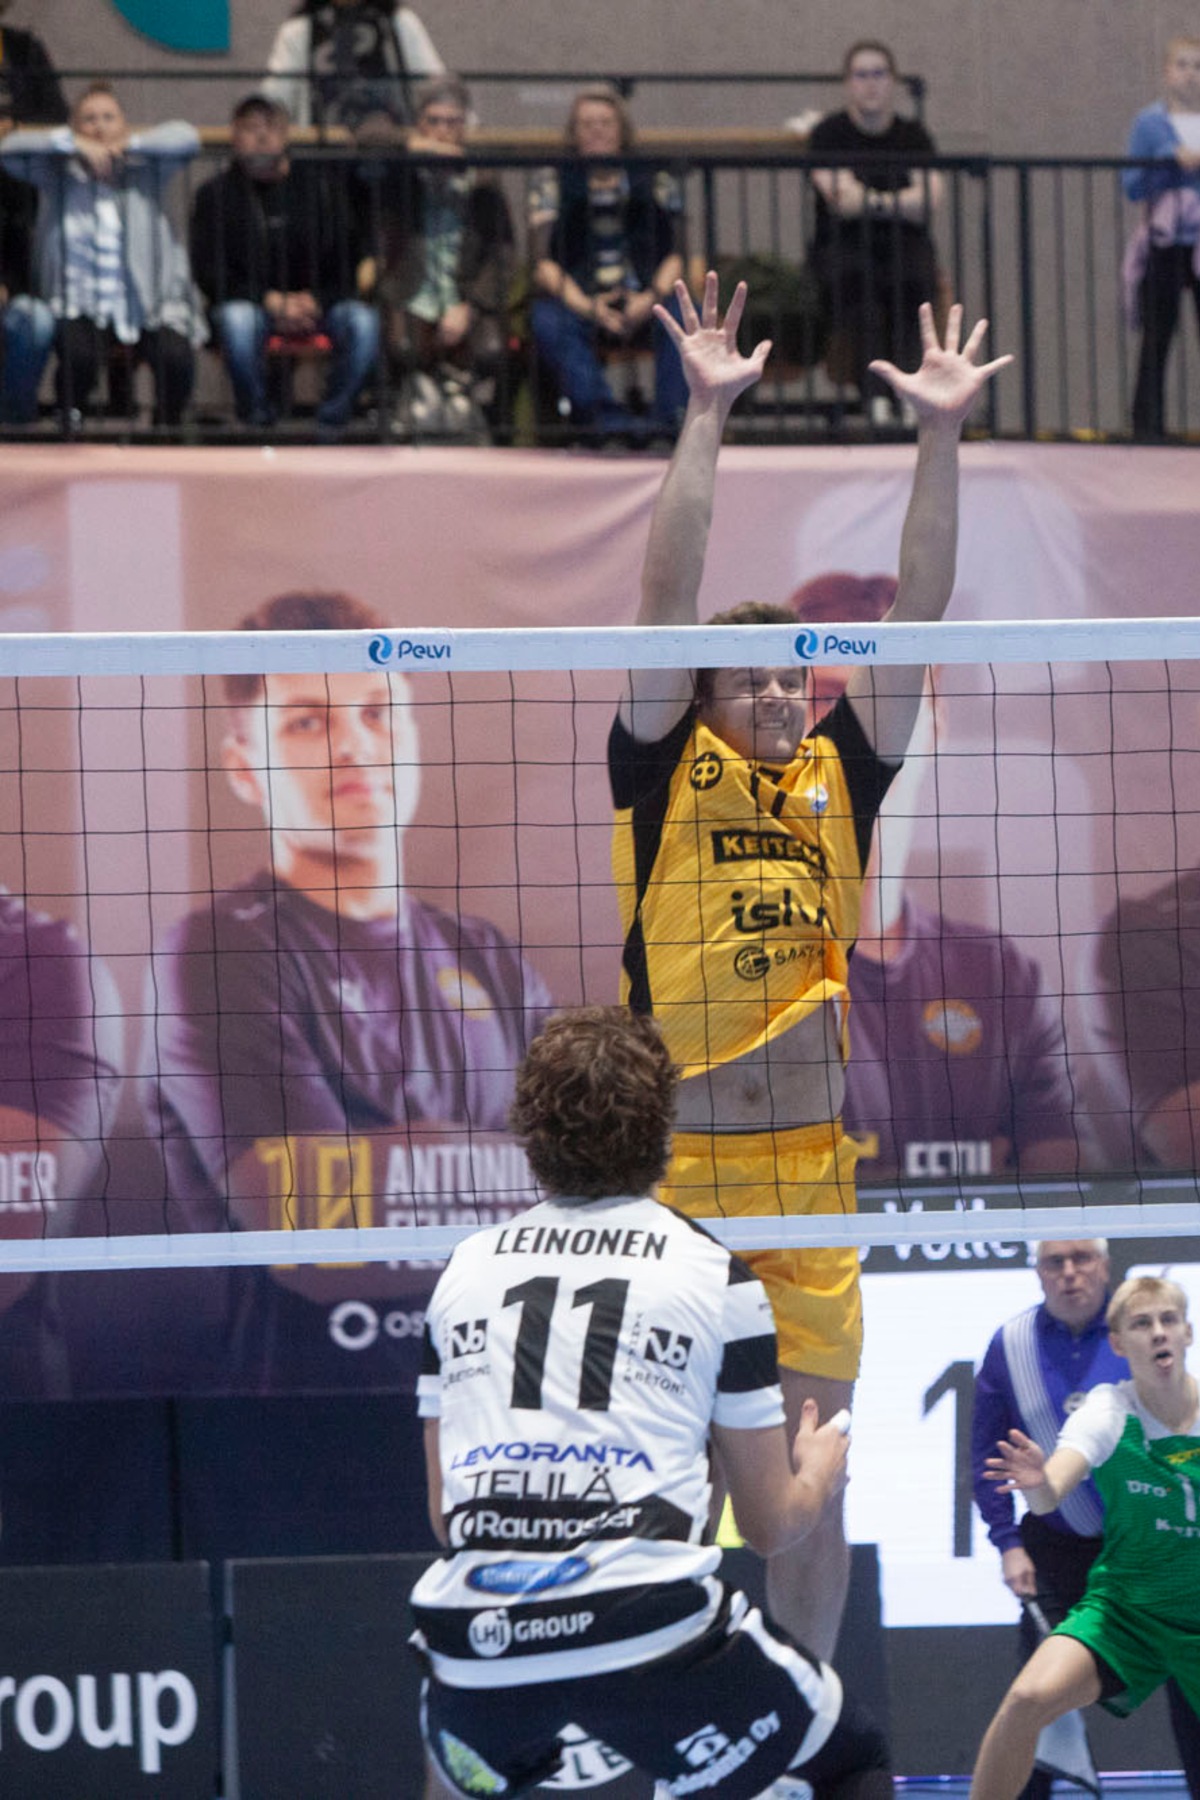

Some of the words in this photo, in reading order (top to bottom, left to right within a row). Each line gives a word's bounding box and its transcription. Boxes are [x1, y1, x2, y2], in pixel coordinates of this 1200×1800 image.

[494, 1227, 667, 1260] LEINONEN
[502, 1276, 631, 1411] 11
[451, 1442, 655, 1471] LEVORANTA
[464, 1466, 616, 1503] TELILÄ
[514, 1611, 594, 1641] GROUP
